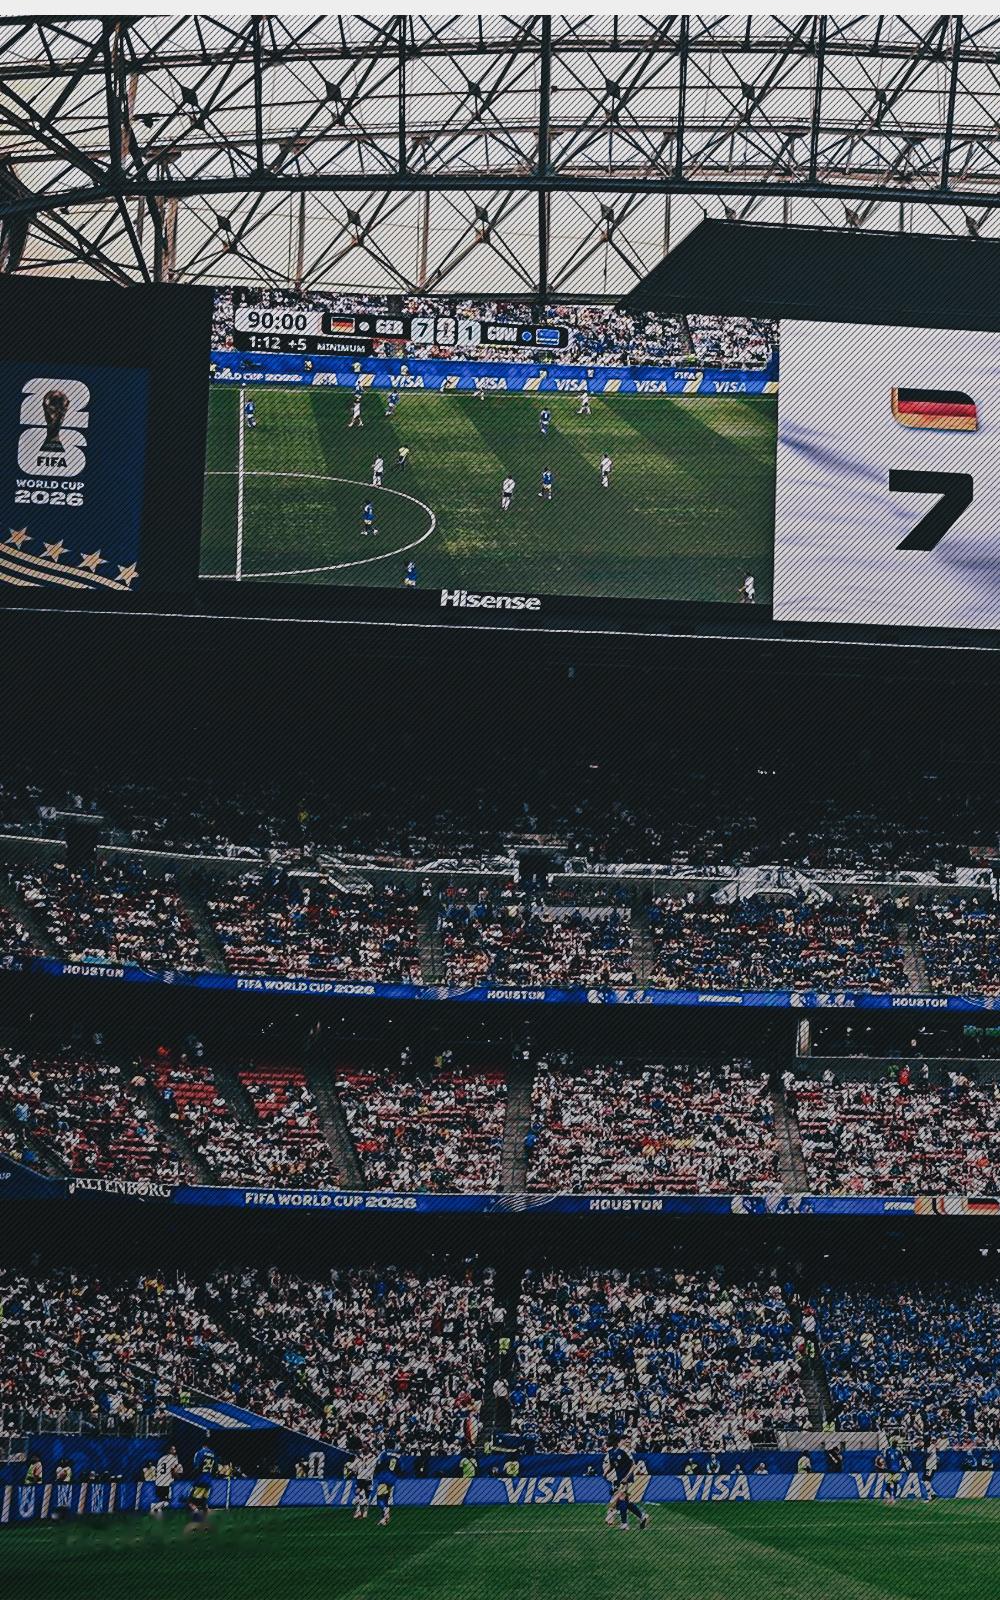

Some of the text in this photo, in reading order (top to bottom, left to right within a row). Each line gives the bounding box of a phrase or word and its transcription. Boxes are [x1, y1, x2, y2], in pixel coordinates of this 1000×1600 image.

[248, 311, 308, 331] 90:00
[375, 319, 518, 342] GER 7 1 CUW
[249, 336, 366, 353] 1:12 +5 MINIMUM
[387, 374, 425, 388] VISA
[674, 370, 696, 380] FIFA
[554, 378, 588, 392] VISA
[633, 379, 668, 393] VISA
[712, 381, 748, 393] VISA
[37, 455, 68, 469] FIFA
[16, 478, 85, 491] WORLD CUP
[14, 489, 84, 507] 2026
[888, 468, 975, 552] 7
[440, 589, 542, 611] Hisense
[62, 964, 125, 978] HOUSTON
[236, 979, 375, 995] FIFA WORLD CUP 2026
[487, 990, 546, 1001] HOUSTON
[891, 997, 949, 1008] HOUSTON
[245, 1192, 417, 1209] FIFA WORLD CUP 2026
[589, 1199, 663, 1211] HOUSTON
[159, 1462, 167, 1474] 3
[318, 1480, 394, 1506] VI
[498, 1477, 576, 1503] VISA
[675, 1475, 752, 1501] VISA
